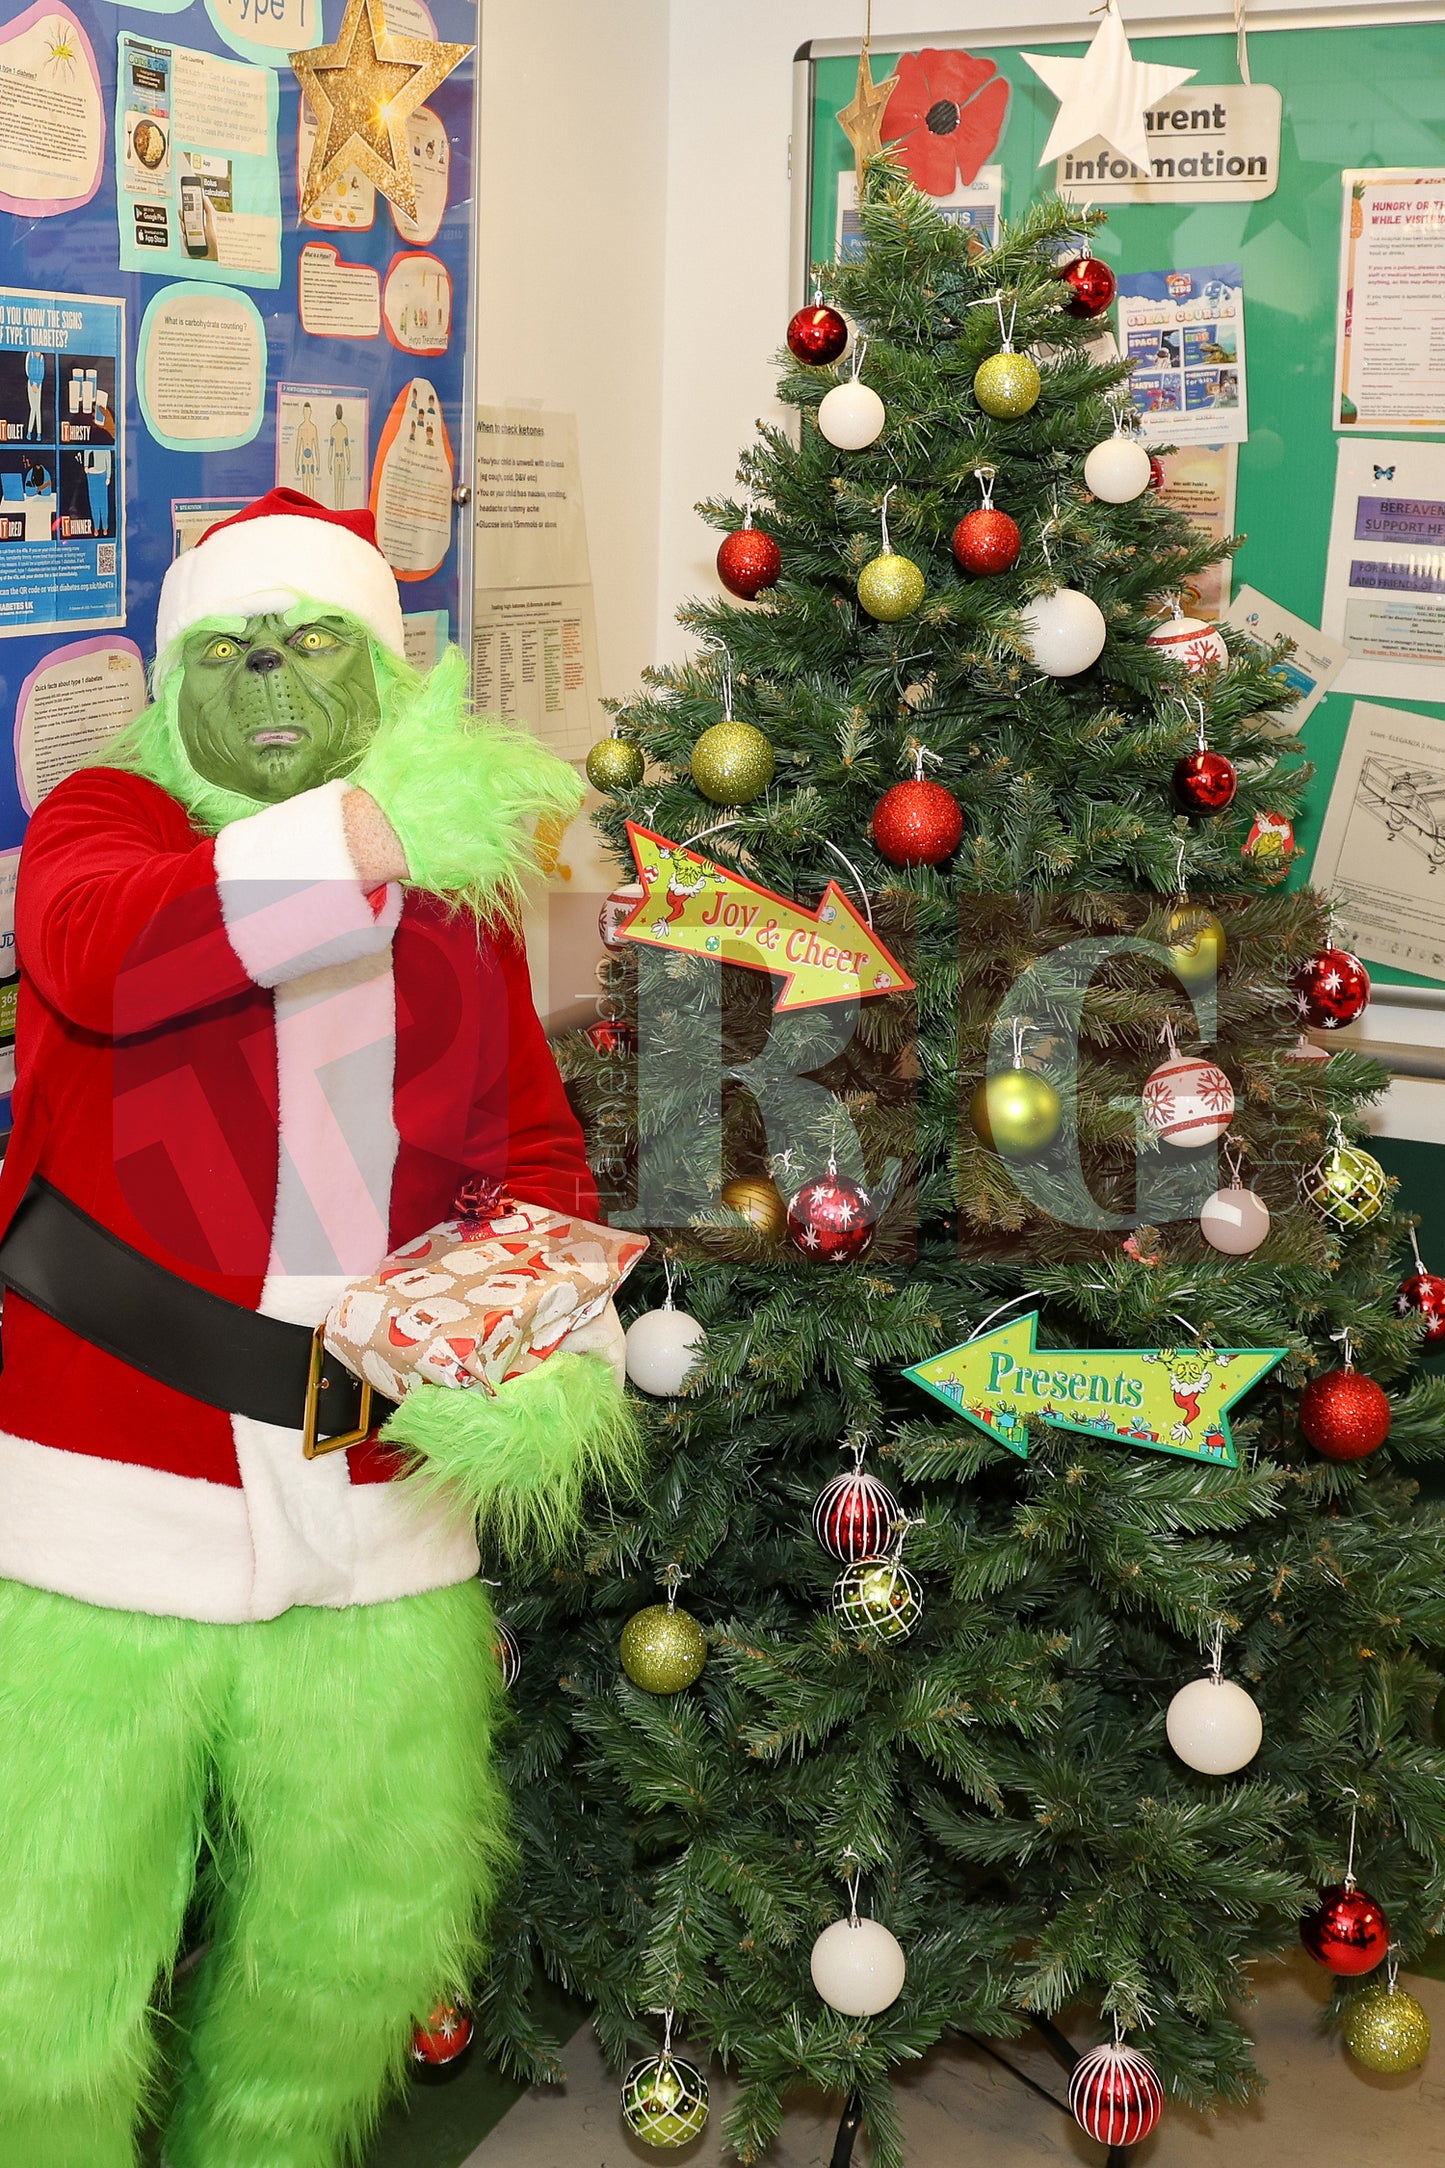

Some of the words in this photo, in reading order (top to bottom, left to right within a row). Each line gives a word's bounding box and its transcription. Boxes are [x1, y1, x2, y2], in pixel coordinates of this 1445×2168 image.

[229, 0, 284, 23] ype
[188, 55, 204, 65] Counting
[16, 68, 38, 80] diabetes?
[1372, 201, 1412, 211] HUNGRY
[1416, 200, 1429, 210] OR
[143, 212, 158, 221] Google
[1371, 215, 1402, 225] WHILE
[144, 235, 153, 243] App
[153, 236, 166, 244] Store
[7, 306, 21, 325] YOU
[23, 307, 46, 327] KNOW
[46, 309, 60, 328] THE
[61, 310, 83, 330] SIGNS
[164, 316, 178, 325] What
[185, 318, 220, 329] carbohydrate
[220, 320, 248, 332] counting?
[1127, 312, 1171, 327] GREAT
[1175, 306, 1236, 322] COURSES
[5, 326, 24, 345] TYPE
[25, 327, 29, 346] 1
[31, 328, 69, 348] DIABETES?
[421, 334, 447, 346] Treatment
[1128, 337, 1159, 348] SPACE
[0, 422, 24, 440] TOILET
[62, 422, 91, 442] THIRSTY
[477, 421, 494, 433] When
[501, 423, 517, 436] check
[518, 424, 545, 438] ketones
[0, 520, 22, 538] TIRED
[62, 518, 92, 536] THINNER
[479, 520, 500, 528] Glucose
[1365, 518, 1424, 532] SUPPORT
[1355, 577, 1376, 586] AND
[1377, 578, 1418, 588] FRIENDS
[1421, 580, 1433, 590] OF
[34, 684, 47, 692] Quick
[58, 680, 70, 688] about
[71, 679, 81, 687] type
[85, 675, 103, 683] diabetes
[1386, 832, 1396, 842] 2
[1428, 865, 1437, 875] 2
[701, 891, 760, 937] Joy
[755, 918, 782, 951] &
[784, 928, 872, 976] Cheer
[984, 1350, 1146, 1409] Presents
